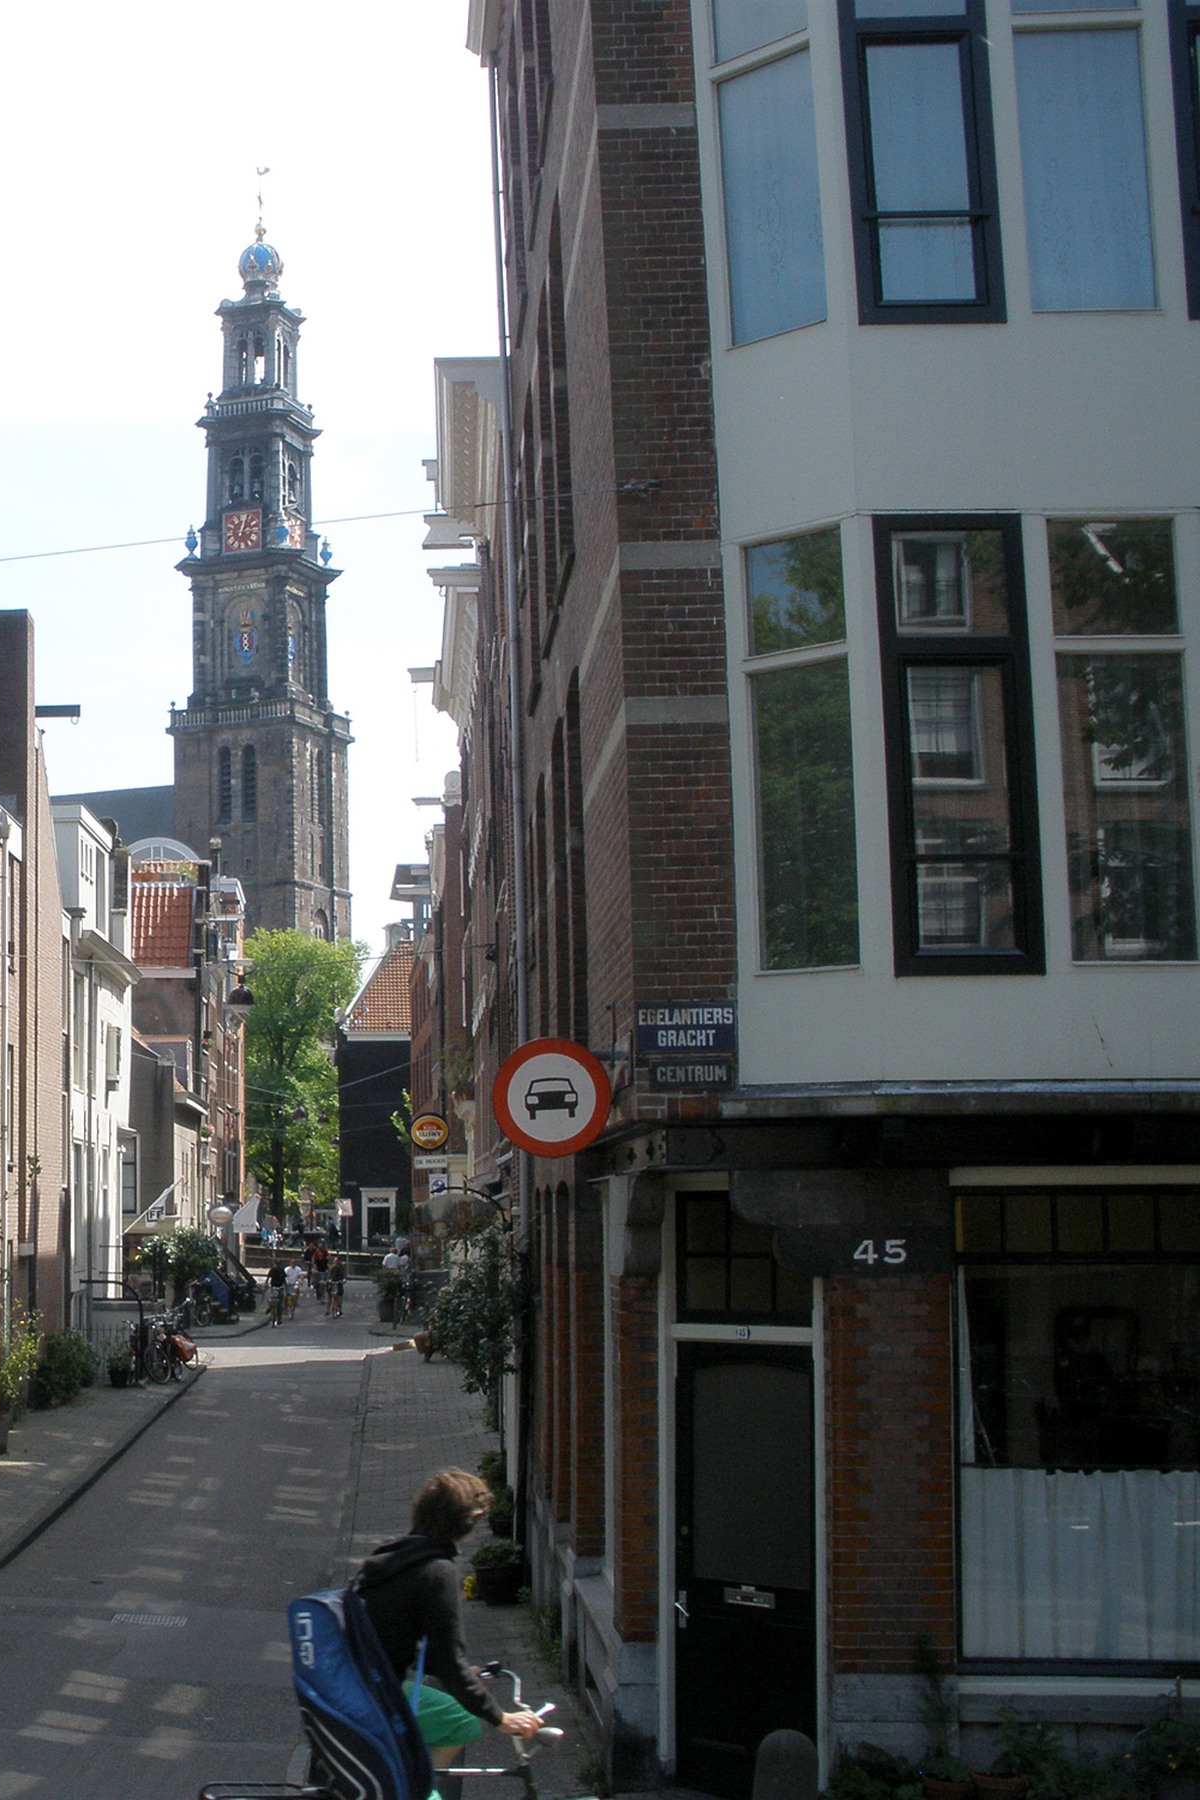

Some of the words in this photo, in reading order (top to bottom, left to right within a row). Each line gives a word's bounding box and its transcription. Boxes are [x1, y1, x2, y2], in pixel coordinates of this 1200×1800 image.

[638, 1007, 733, 1026] EGELANTIERS
[657, 1029, 716, 1047] GRACHT
[657, 1065, 727, 1082] CENTRUM
[853, 1239, 907, 1265] 45
